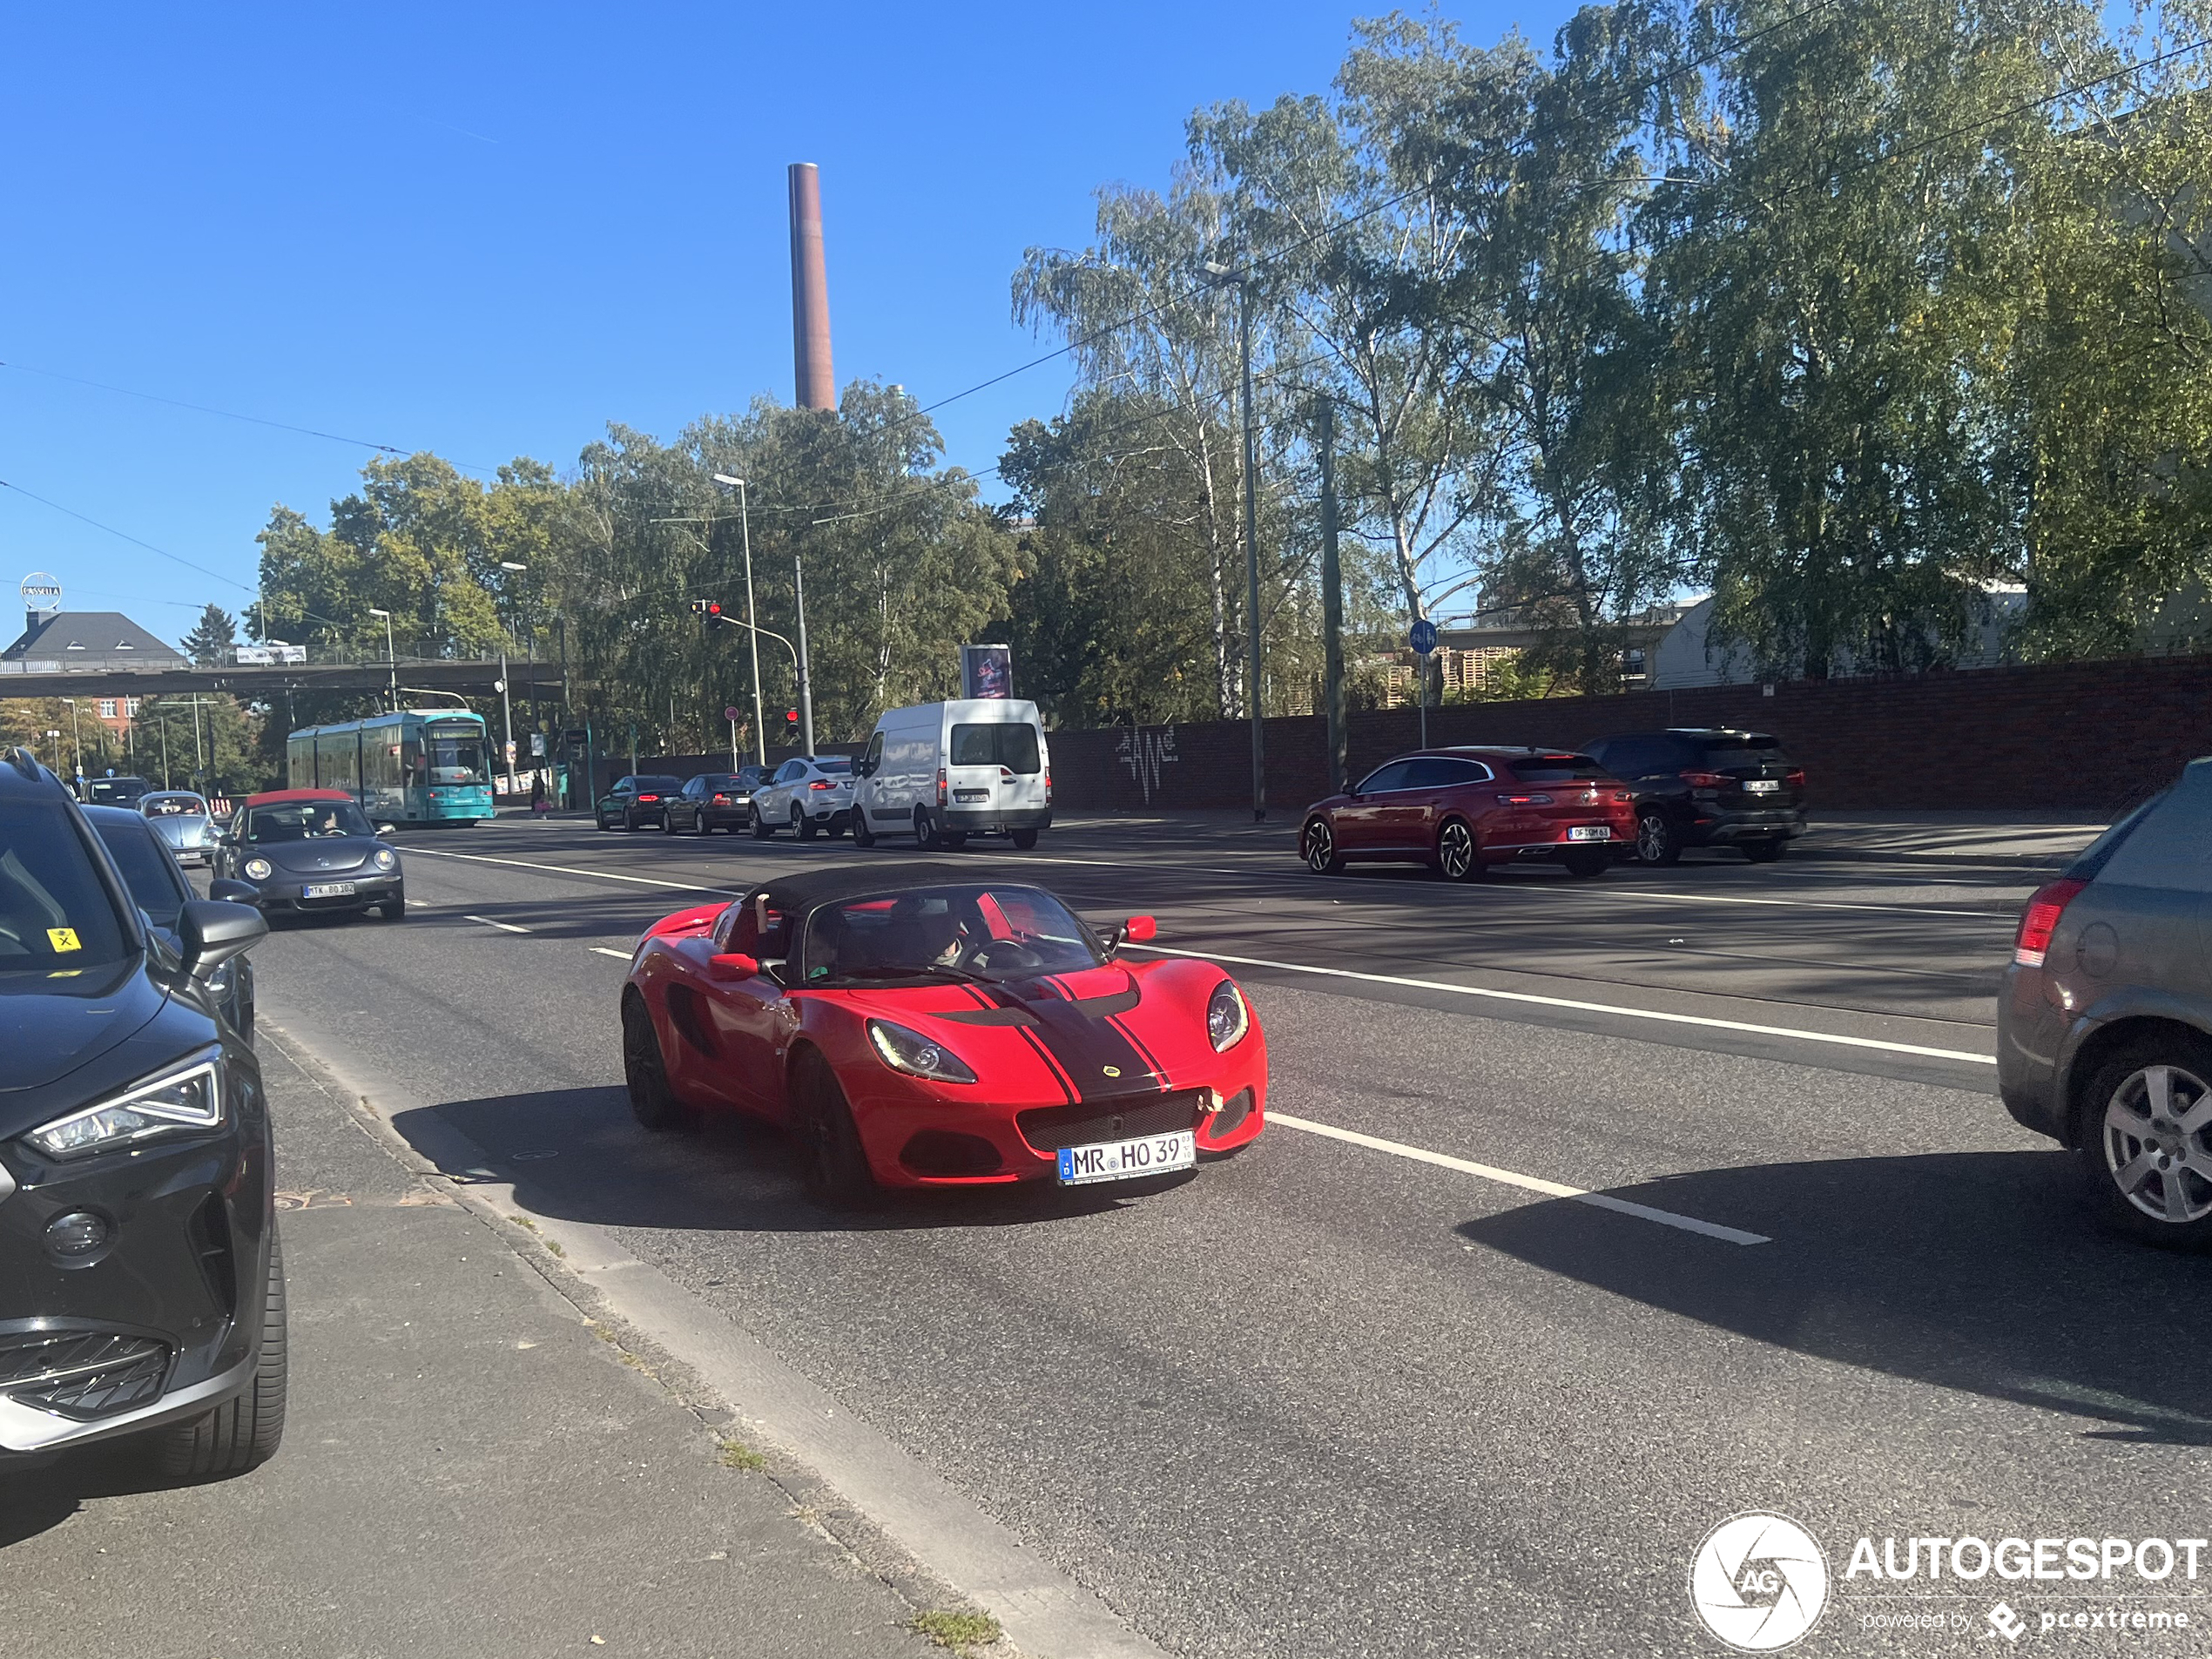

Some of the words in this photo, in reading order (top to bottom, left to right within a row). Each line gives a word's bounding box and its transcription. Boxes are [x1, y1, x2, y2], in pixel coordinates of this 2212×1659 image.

[24, 587, 59, 596] CASSELLA
[308, 887, 324, 895] MTK
[1063, 1167, 1069, 1176] D
[1073, 1149, 1105, 1175] MR
[1121, 1143, 1150, 1169] HO
[1156, 1137, 1179, 1163] 39
